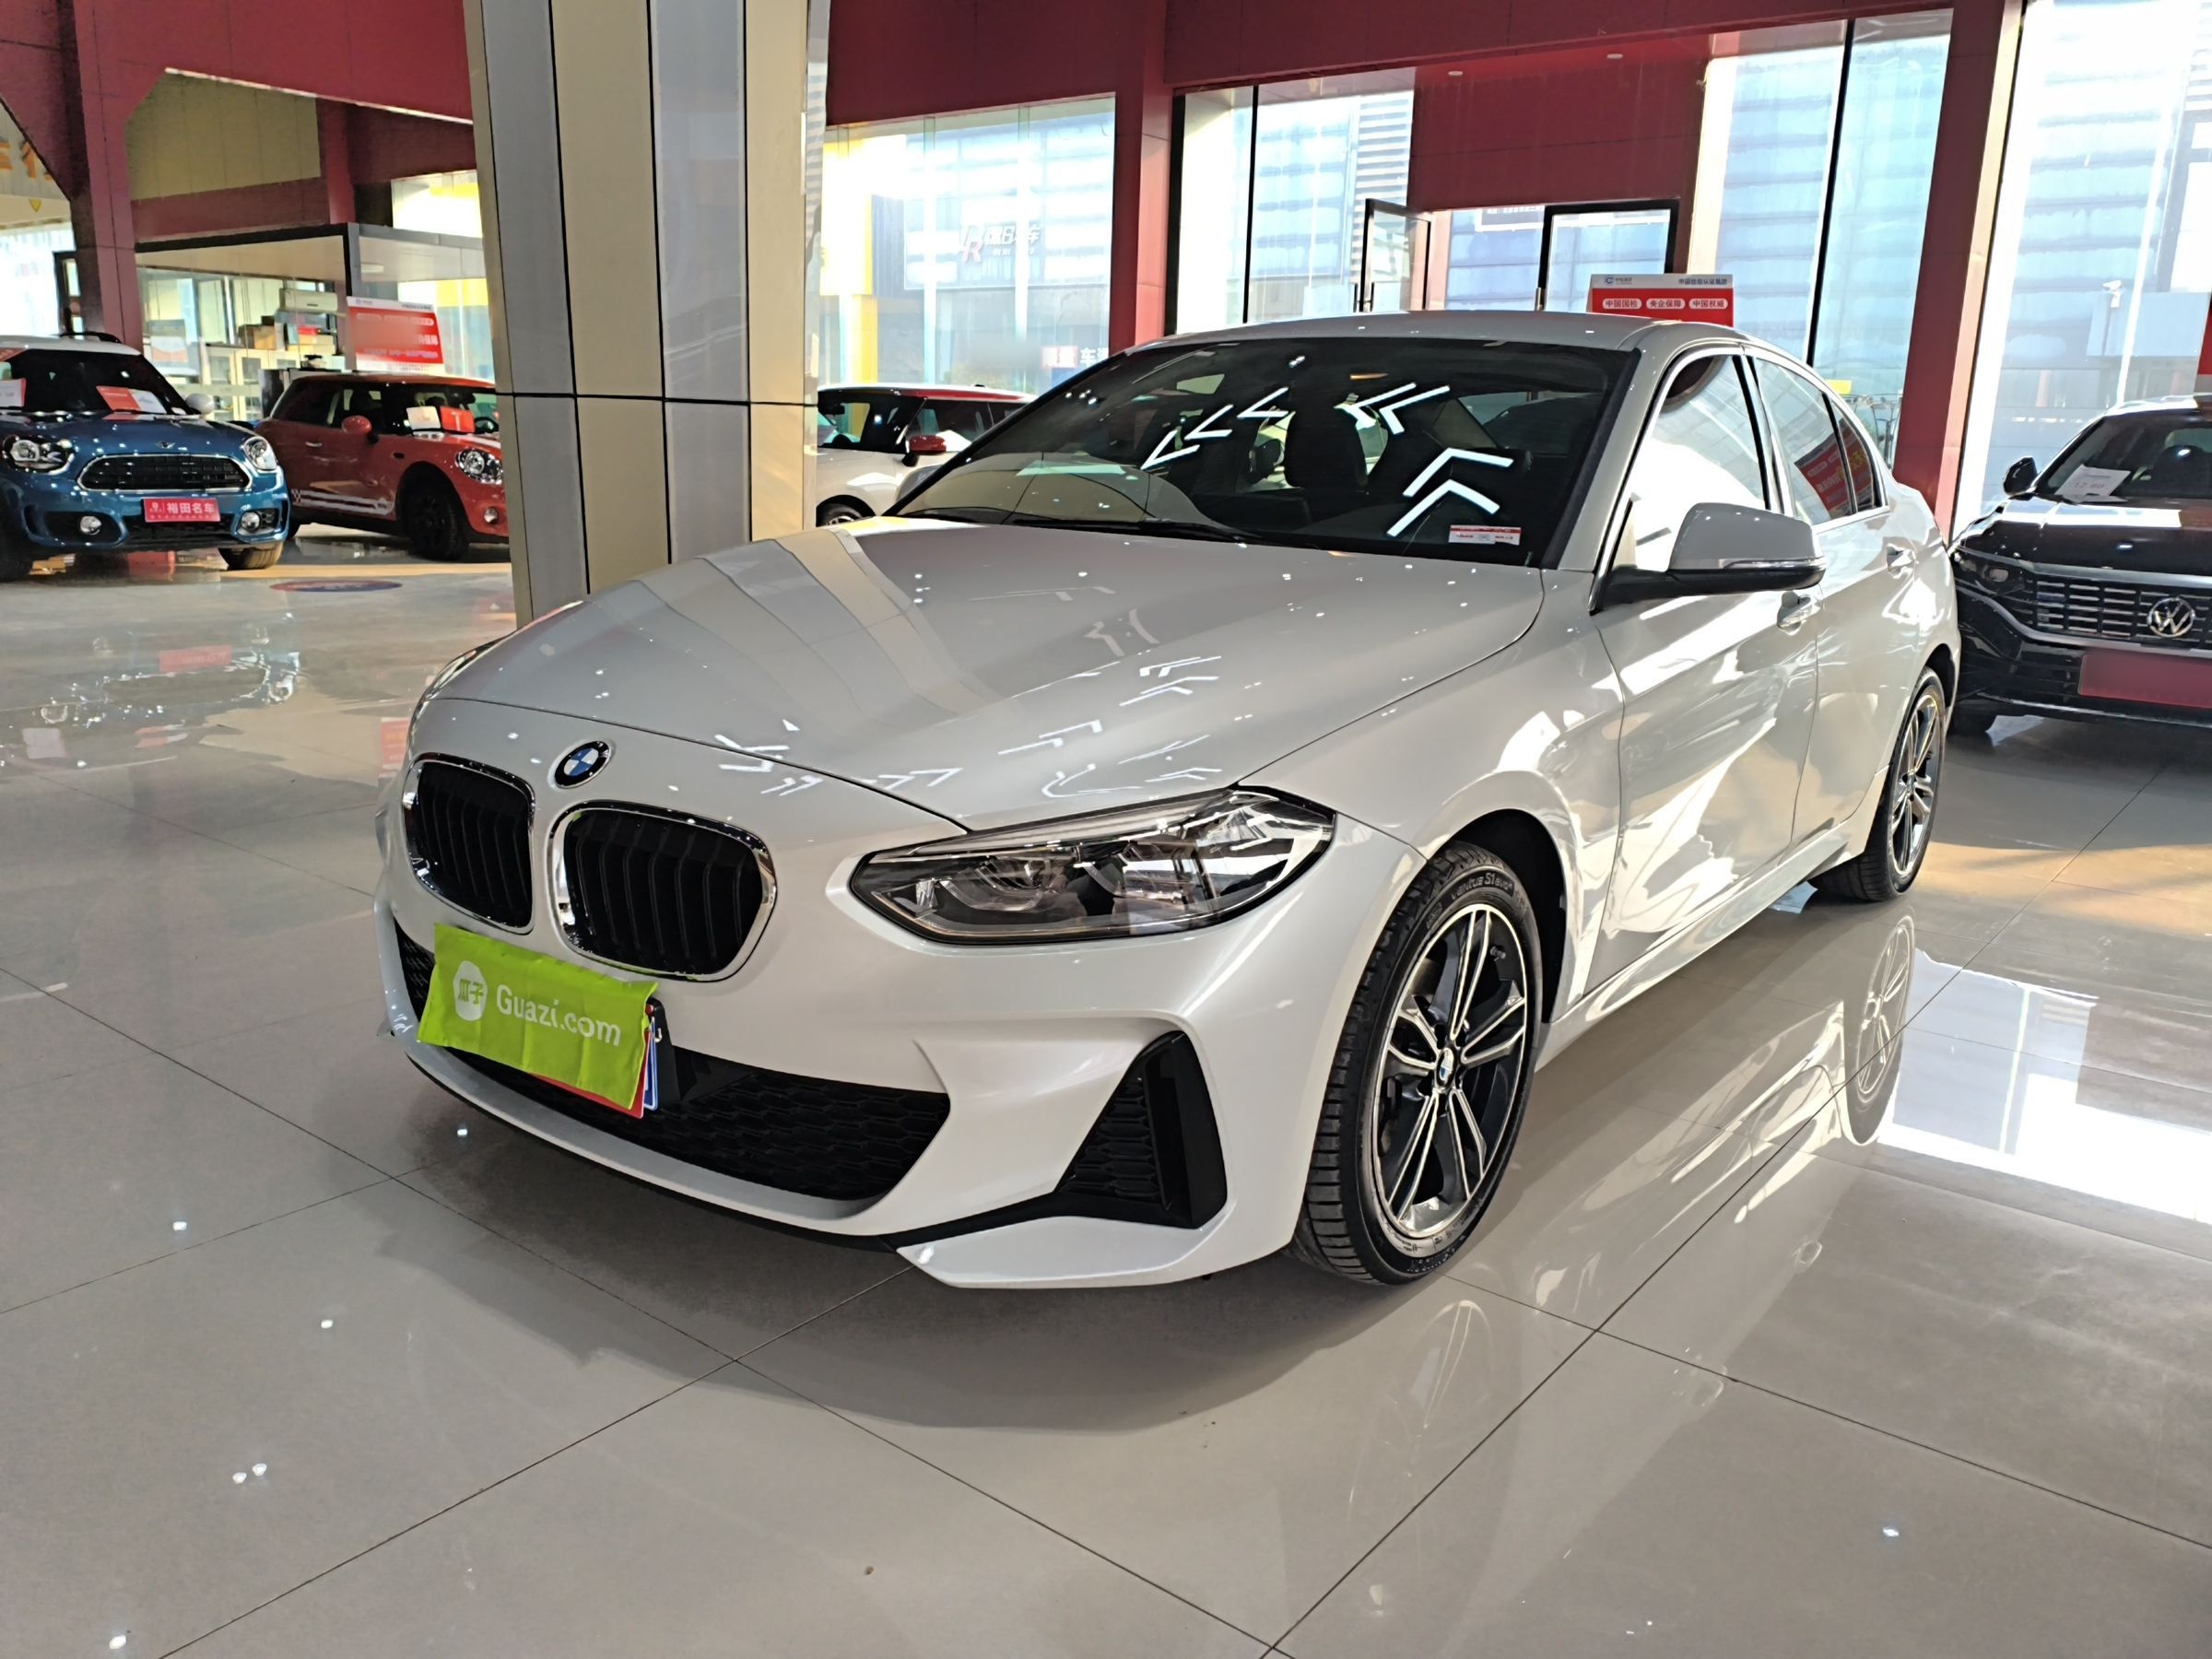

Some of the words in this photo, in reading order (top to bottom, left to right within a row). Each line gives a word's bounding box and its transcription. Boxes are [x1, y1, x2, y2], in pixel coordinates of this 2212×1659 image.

[1605, 298, 1639, 309] 中国国检
[1649, 299, 1682, 309] 央企保障
[1692, 299, 1725, 309] 中国权威
[458, 978, 485, 1006] 瓜子
[496, 984, 622, 1047] Guazi.com
